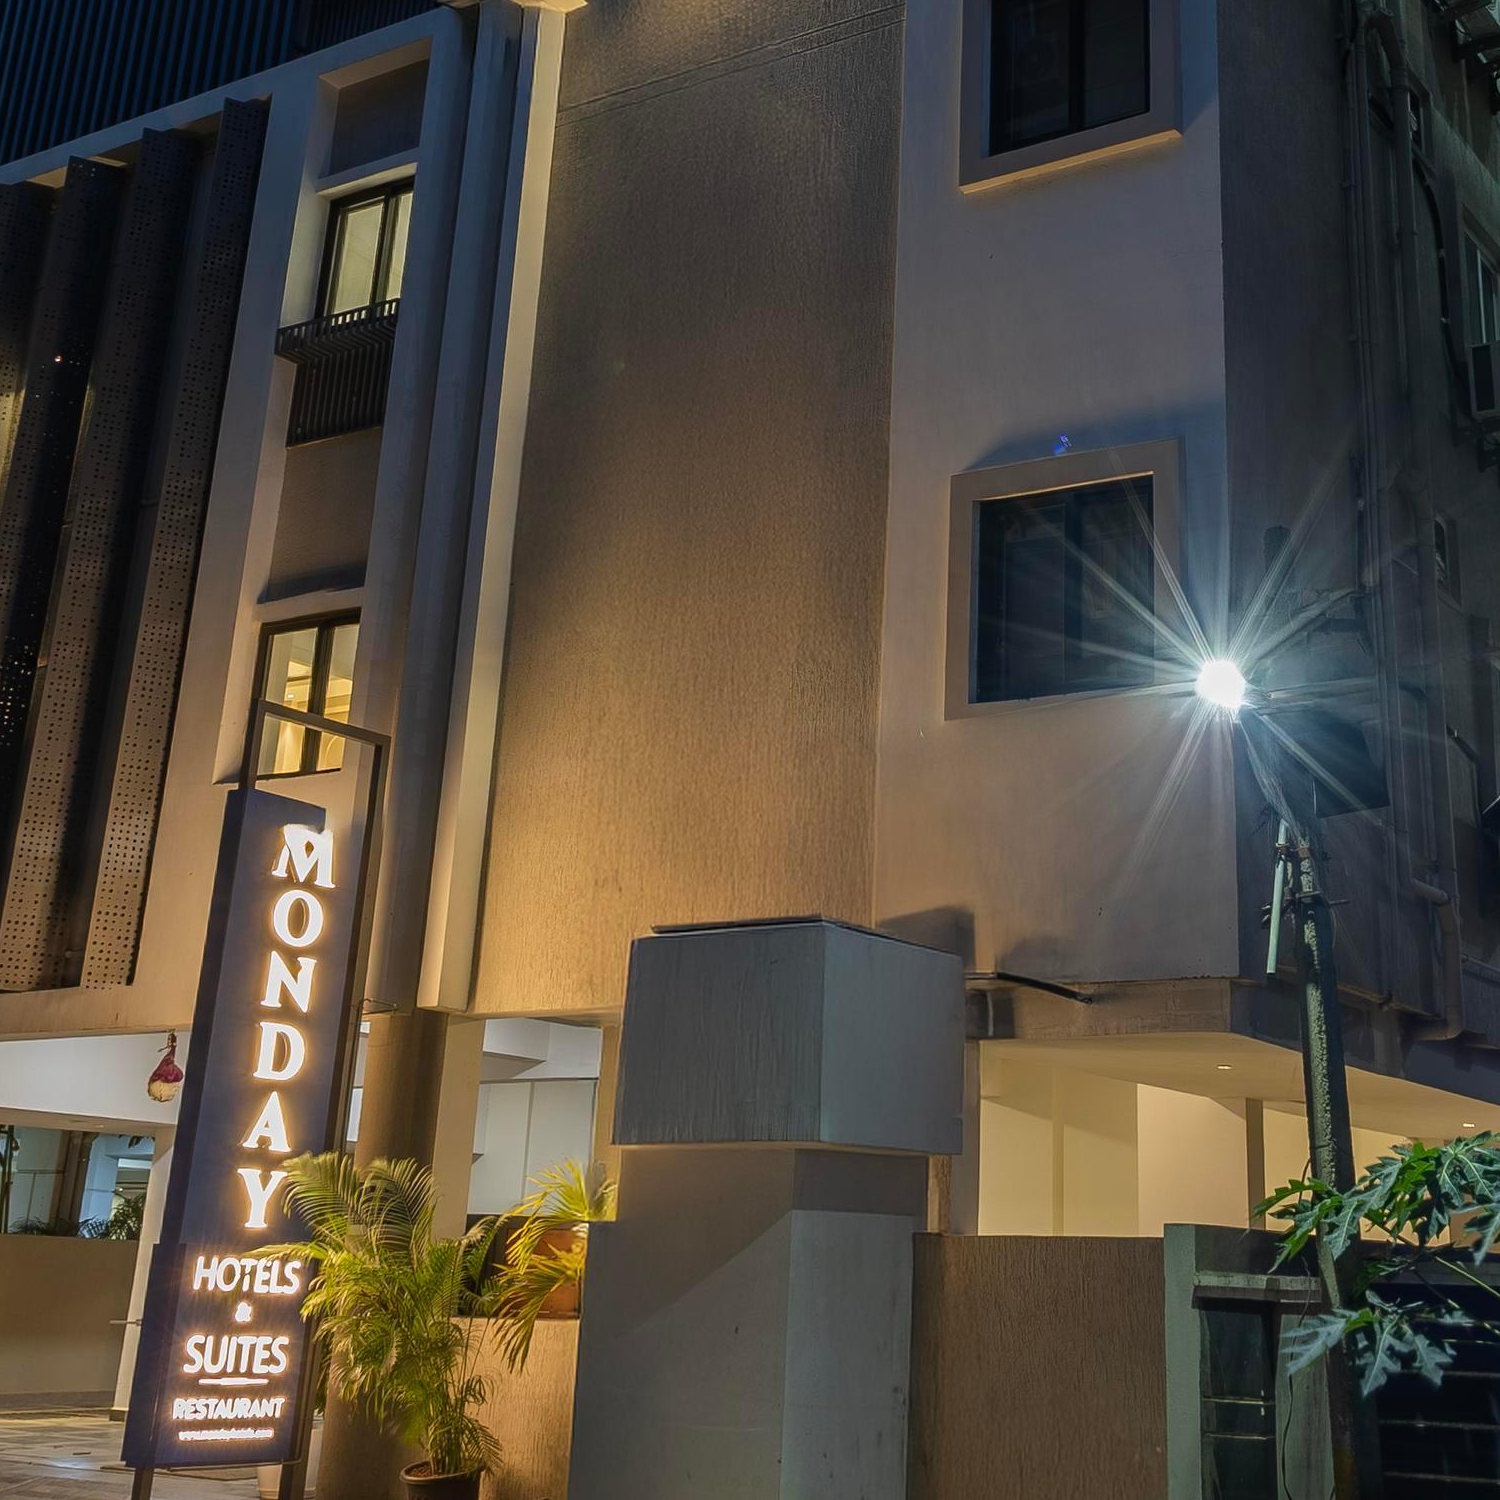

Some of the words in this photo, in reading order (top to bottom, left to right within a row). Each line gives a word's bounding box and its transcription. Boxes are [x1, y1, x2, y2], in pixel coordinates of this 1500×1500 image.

[238, 823, 336, 1229] MONDAY
[192, 1255, 302, 1295] HOTELS
[234, 1301, 252, 1323] &
[182, 1334, 290, 1374] SUITES
[172, 1397, 286, 1420] RESTAURANT
